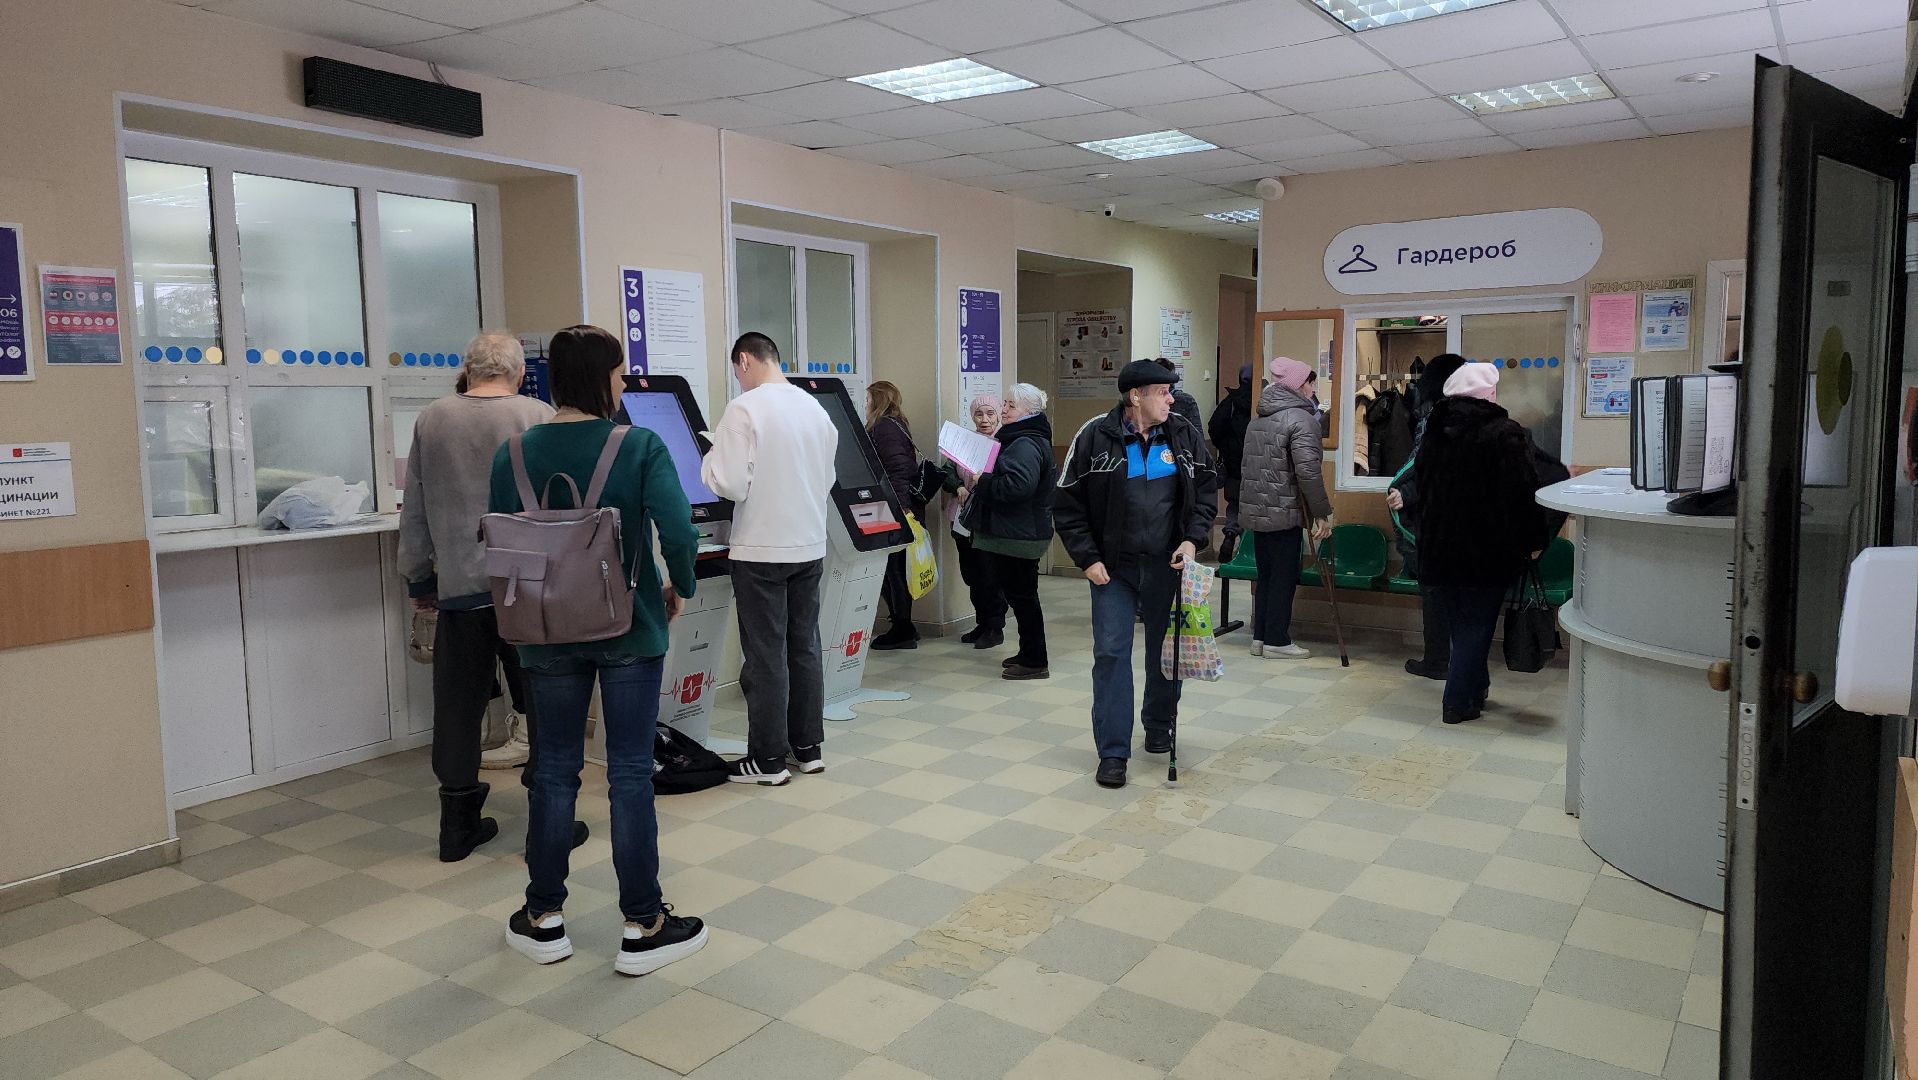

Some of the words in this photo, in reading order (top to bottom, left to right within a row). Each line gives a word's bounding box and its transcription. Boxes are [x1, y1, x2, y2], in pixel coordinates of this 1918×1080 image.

[1397, 239, 1516, 266] Гардероб
[626, 277, 639, 297] 3
[961, 291, 968, 306] 3
[961, 333, 969, 349] 2
[0, 510, 23, 518] ИНЕТ
